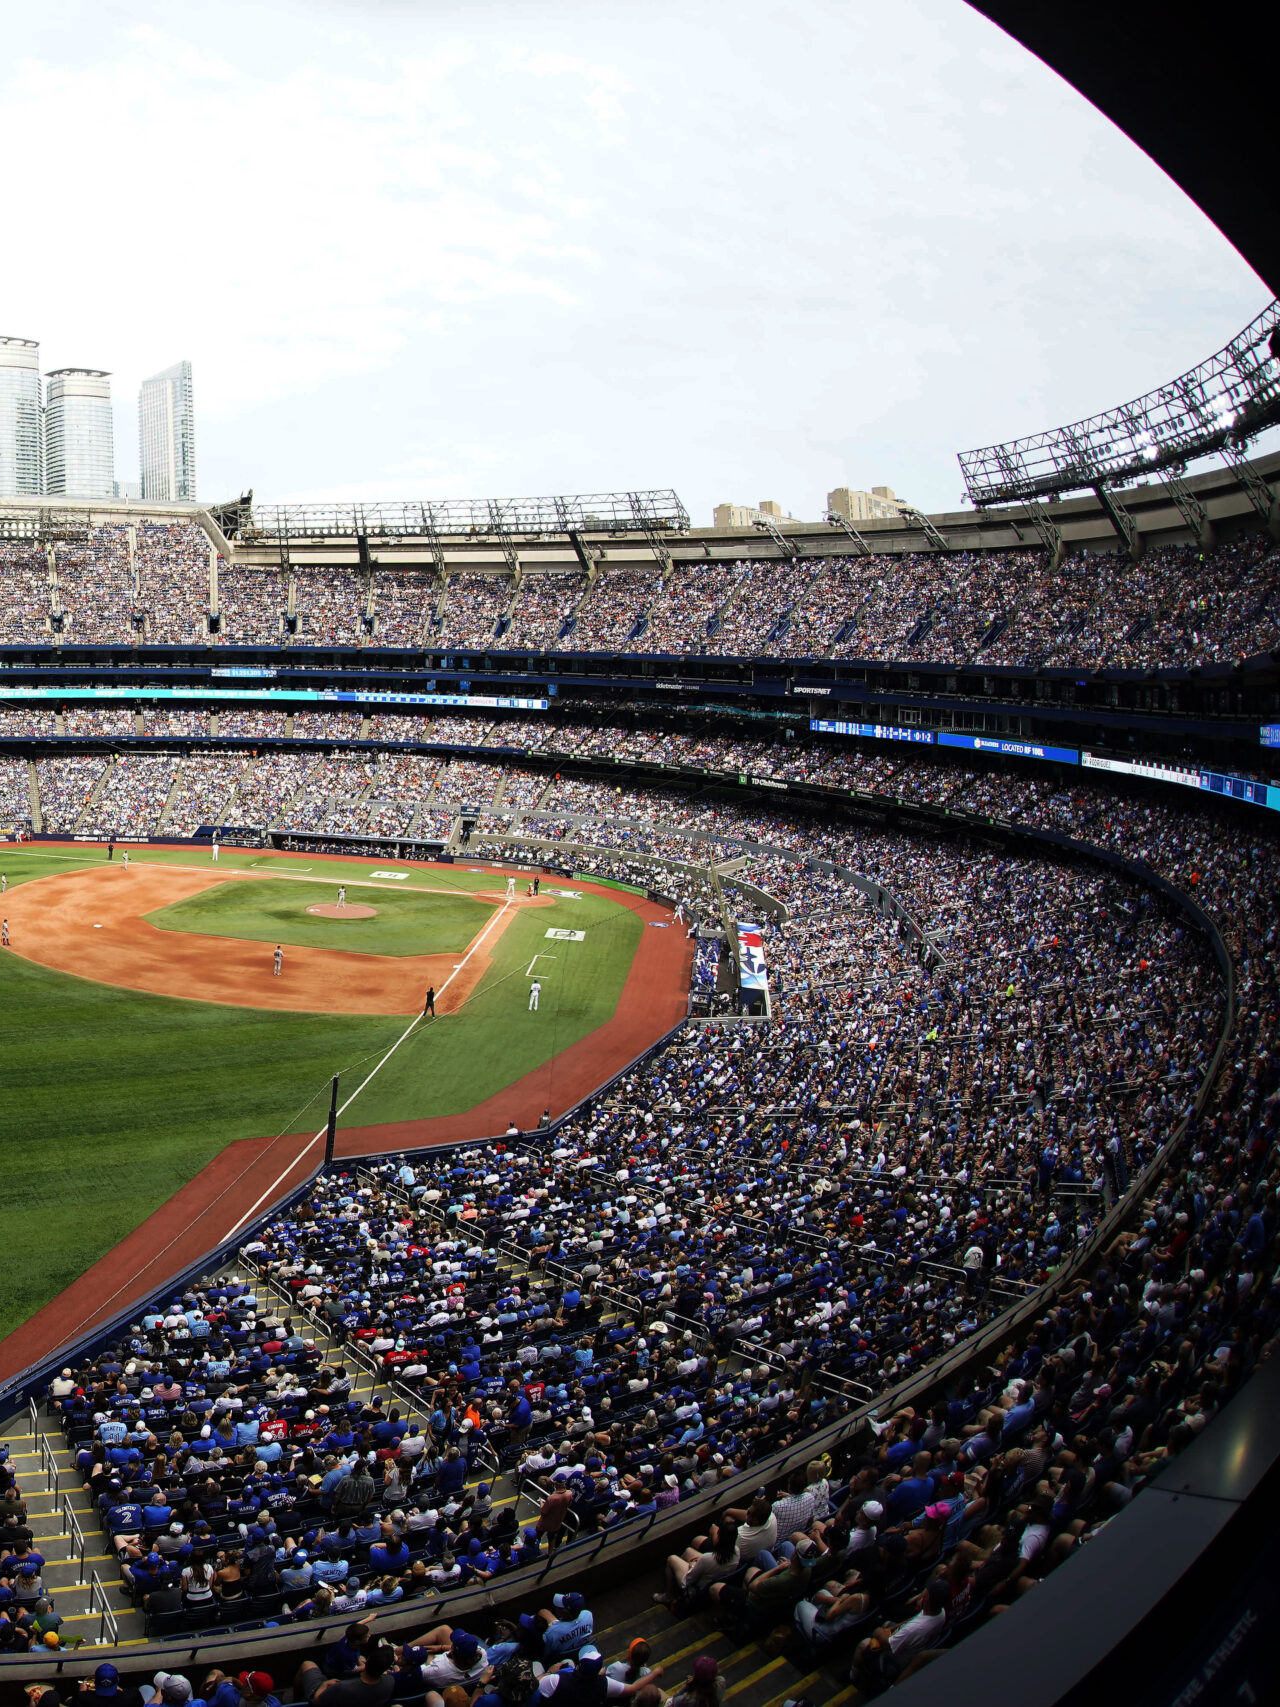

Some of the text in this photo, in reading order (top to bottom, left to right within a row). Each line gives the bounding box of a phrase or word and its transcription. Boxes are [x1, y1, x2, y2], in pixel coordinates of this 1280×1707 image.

[794, 686, 831, 695] SPORTSNET
[1001, 743, 1024, 754] LOCATED
[1024, 746, 1031, 755] RF
[1089, 757, 1111, 769] RODRIGUEZ
[760, 779, 788, 790] Clubhouse
[108, 1432, 120, 1441] 11
[122, 1512, 133, 1524] 2
